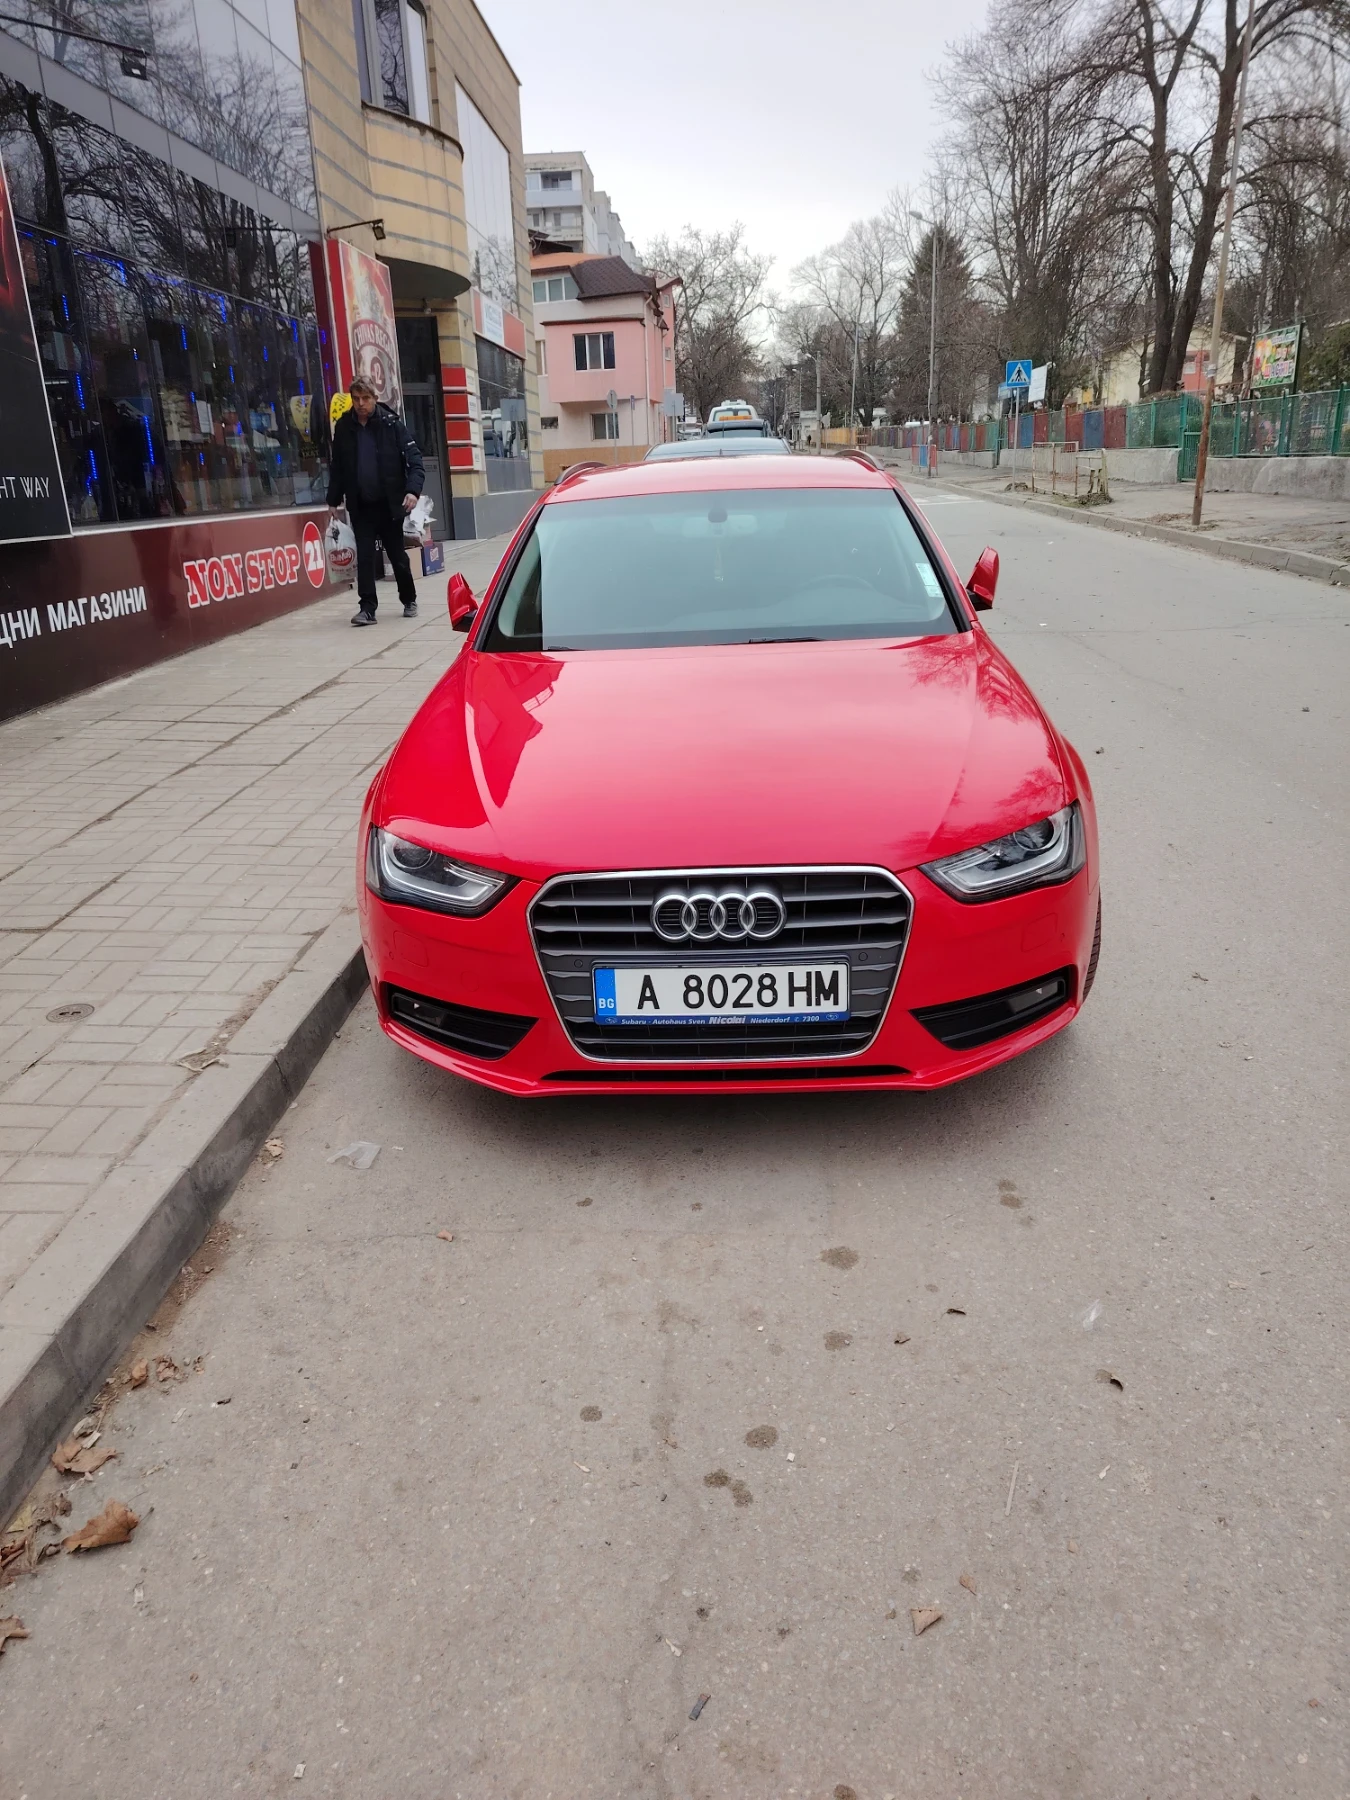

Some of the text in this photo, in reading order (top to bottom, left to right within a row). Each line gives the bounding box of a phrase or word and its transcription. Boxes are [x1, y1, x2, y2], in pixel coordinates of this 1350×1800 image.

[354, 323, 375, 350] CHIVAS
[19, 476, 50, 498] WAY
[183, 540, 324, 609] NON STOP 21
[46, 586, 147, 633] МАГАЗИНИ
[598, 998, 615, 1009] BG
[637, 970, 840, 1010] A 8028 HM
[708, 1015, 746, 1025] Nicolai
[750, 1016, 791, 1024] Niederdorf
